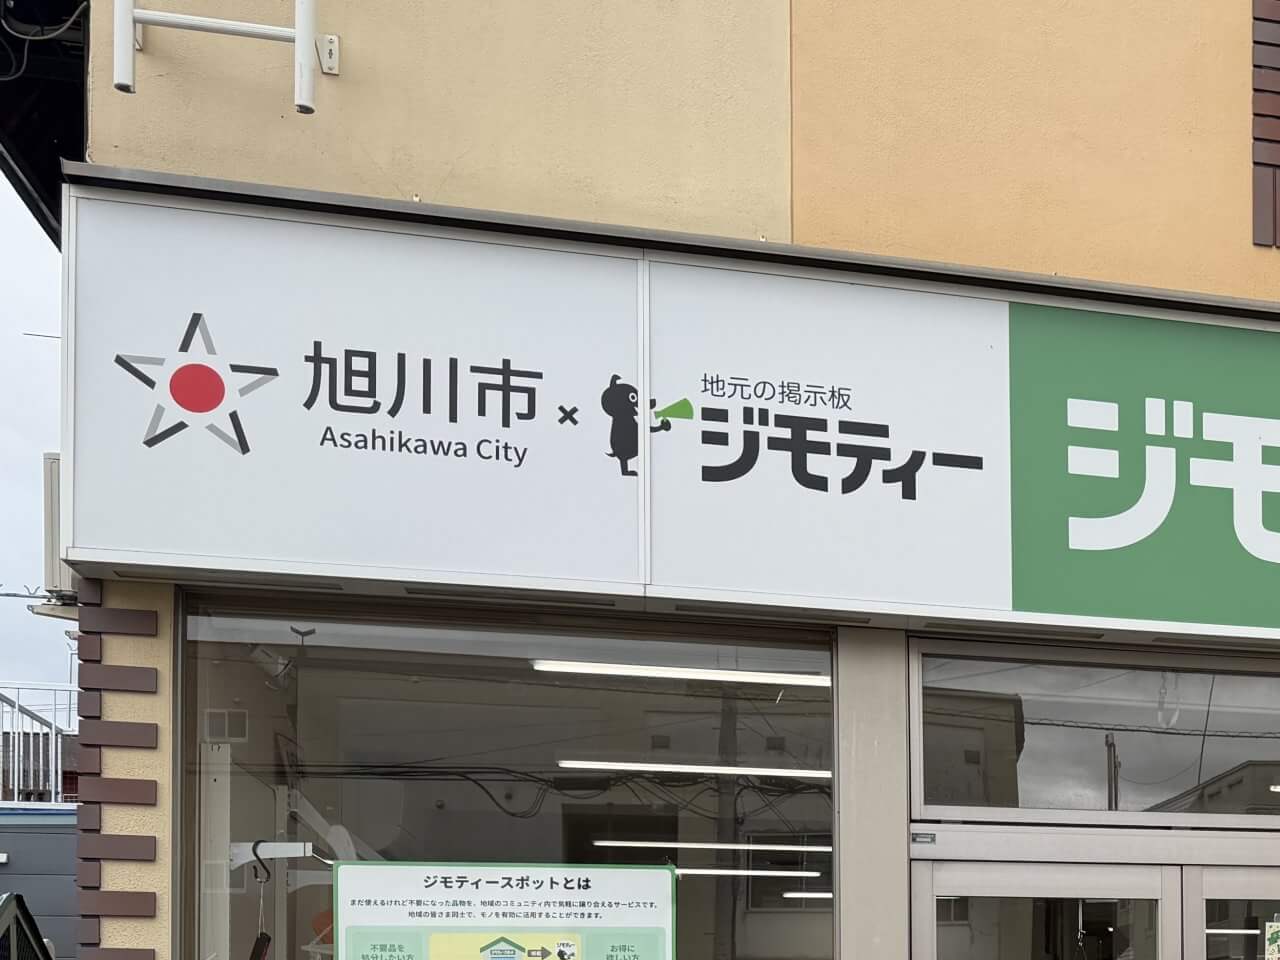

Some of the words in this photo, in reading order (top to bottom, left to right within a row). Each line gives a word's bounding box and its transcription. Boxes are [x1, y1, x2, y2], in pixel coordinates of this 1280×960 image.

[303, 341, 544, 429] 旭川市
[700, 372, 852, 412] 地元の掲示板
[319, 425, 468, 459] Asahikawa
[476, 437, 528, 469] City
[700, 407, 984, 501] ジモティー
[423, 874, 592, 891] ジモティースポットとは
[370, 943, 405, 952] 不要品を
[610, 944, 636, 953] お得に
